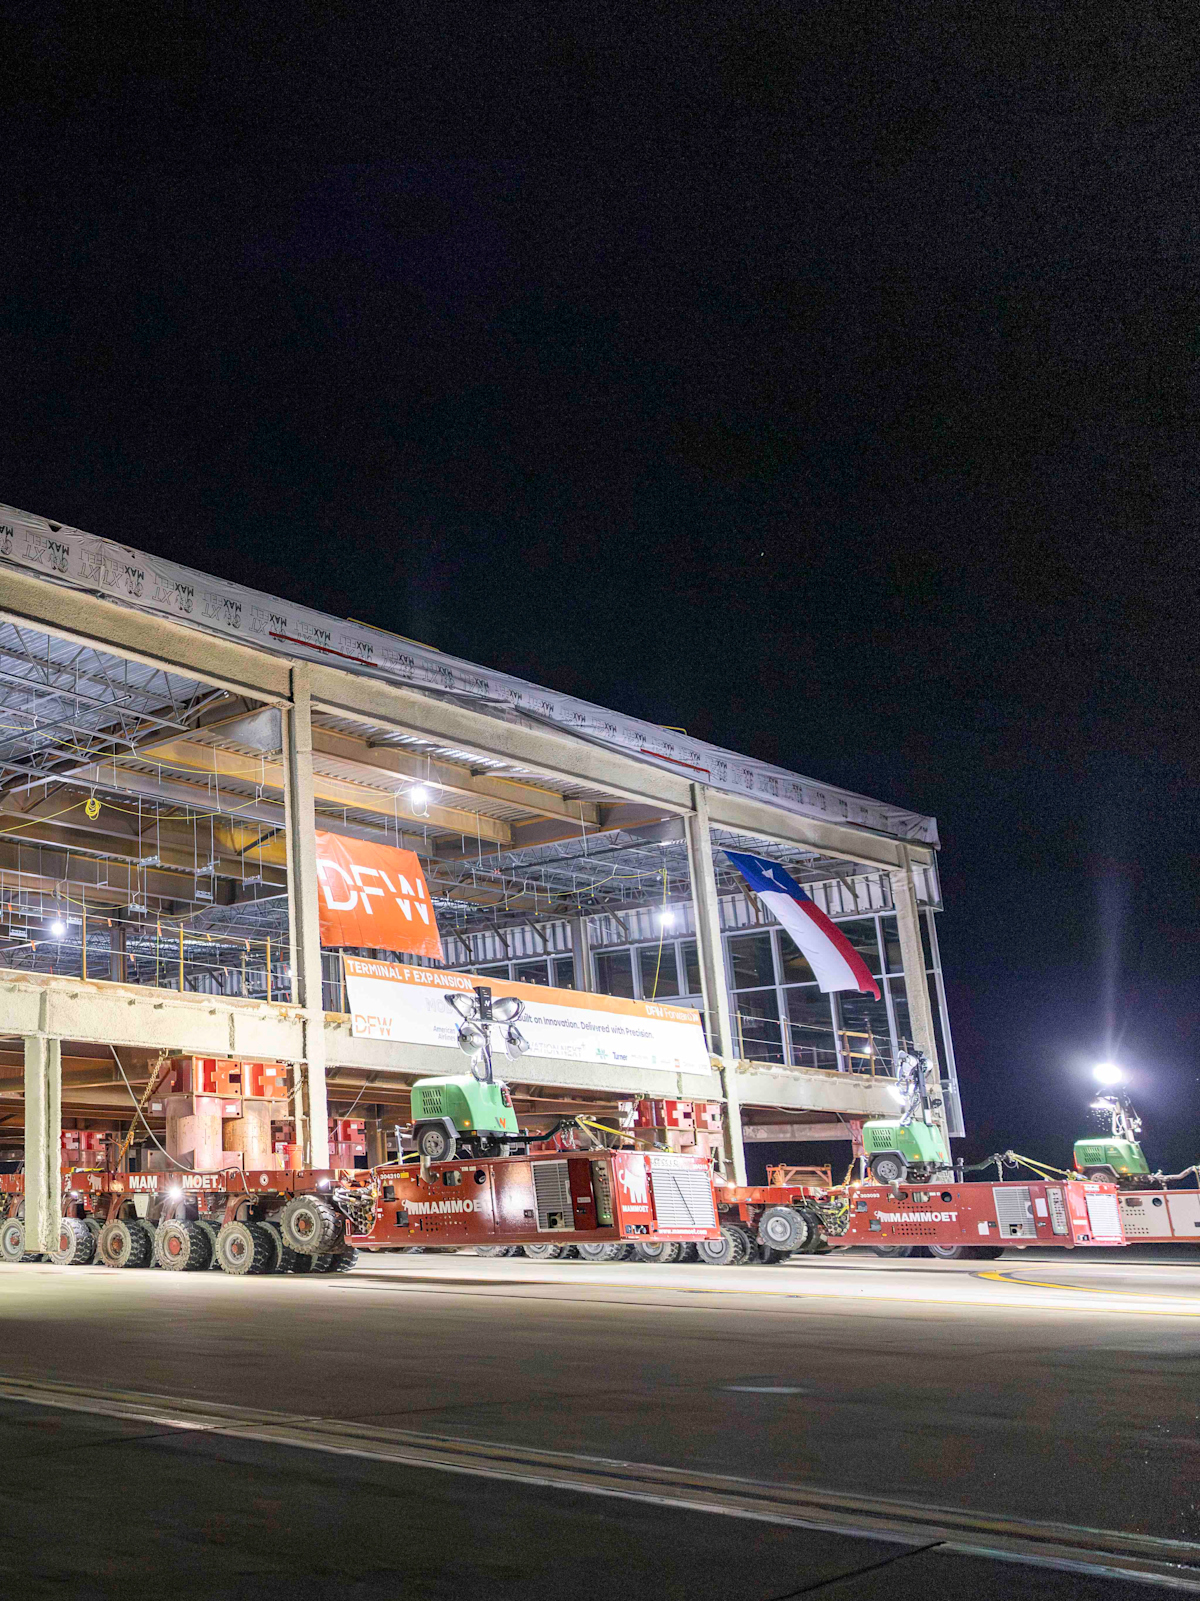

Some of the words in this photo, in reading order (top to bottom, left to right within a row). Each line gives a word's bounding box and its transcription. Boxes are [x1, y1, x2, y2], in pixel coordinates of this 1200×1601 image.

[316, 859, 430, 925] DFW
[347, 960, 402, 980] TERMINAL
[405, 970, 411, 981] F
[414, 970, 474, 990] EXPANSION
[645, 1004, 663, 1017] DFW
[663, 1007, 691, 1022] Forward
[355, 1014, 393, 1037] DFW
[433, 1025, 456, 1034] American
[534, 1016, 543, 1024] on
[543, 1016, 580, 1030] Innovation.
[580, 1021, 610, 1034] Delivered
[611, 1025, 625, 1036] with
[626, 1028, 655, 1040] Precision.
[612, 1051, 628, 1061] Turner
[129, 1175, 158, 1189] MAM
[183, 1174, 218, 1189] MOET
[622, 1204, 649, 1213] MAMMOET
[889, 1212, 958, 1222] MAMMOET
